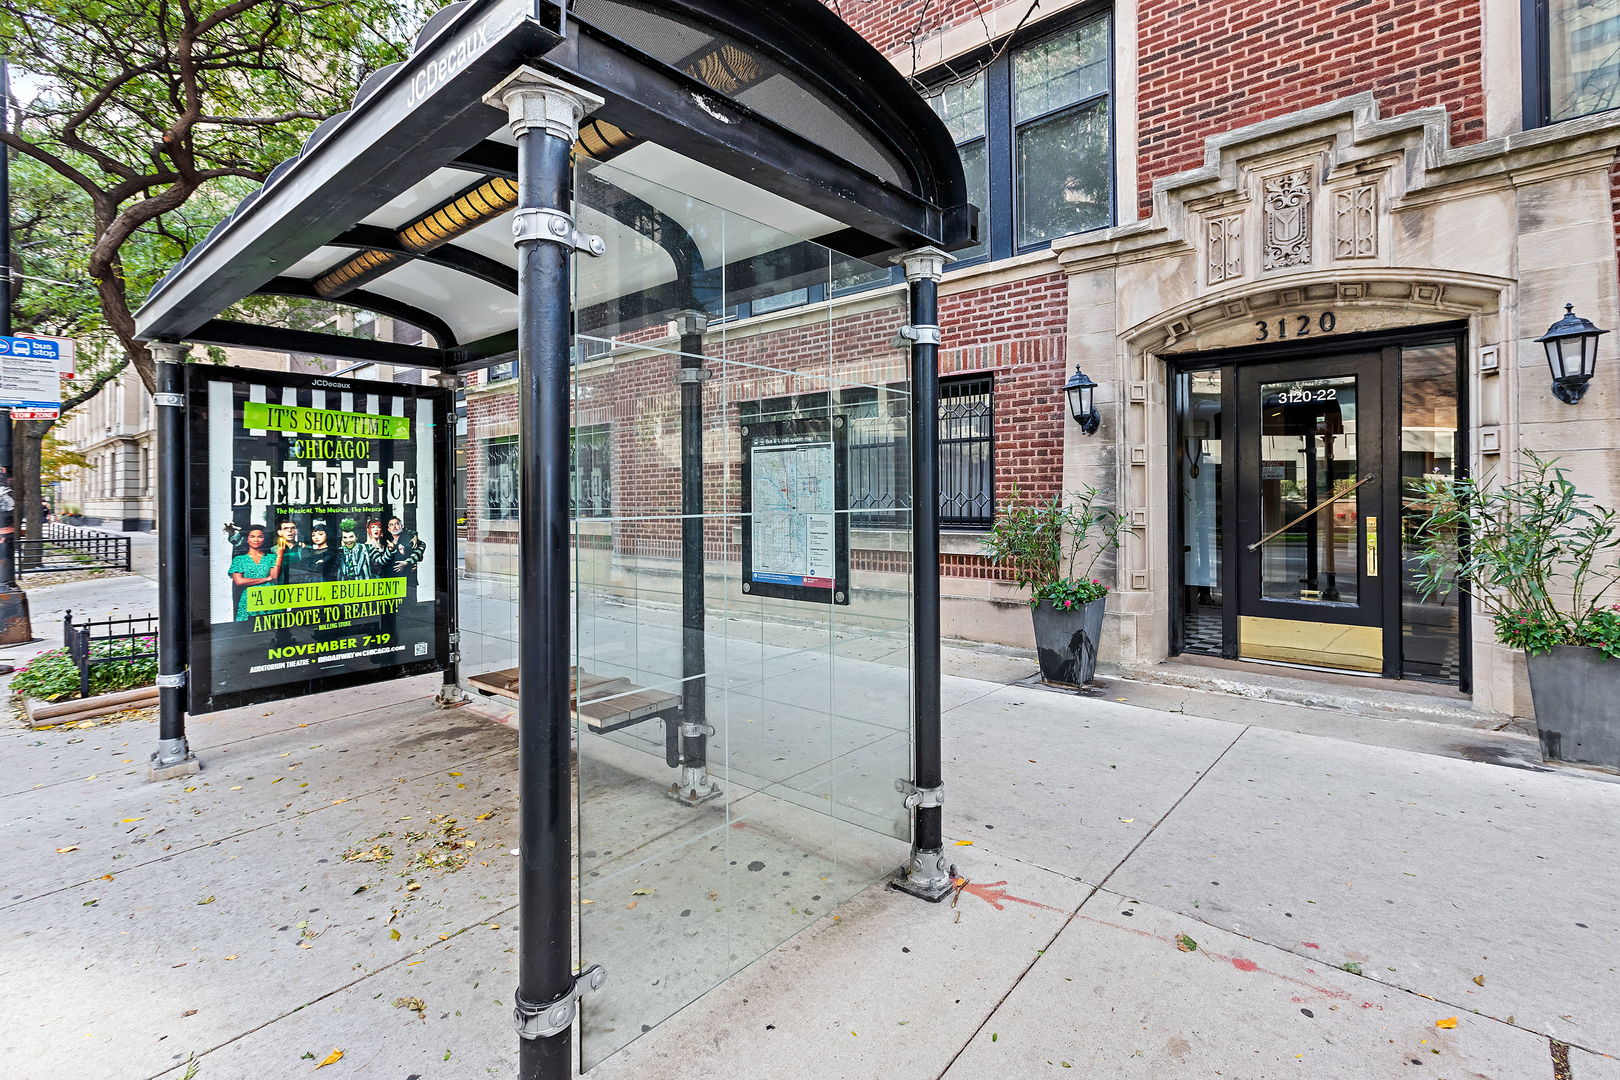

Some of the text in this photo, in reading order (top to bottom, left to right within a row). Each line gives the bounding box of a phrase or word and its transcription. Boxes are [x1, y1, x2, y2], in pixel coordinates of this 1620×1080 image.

[407, 24, 488, 108] JCDecaux
[1255, 311, 1336, 341] 3120
[33, 341, 52, 350] bus
[33, 349, 56, 358] stop
[311, 379, 351, 390] JCDecaux
[1278, 388, 1337, 404] 3120-22
[267, 407, 298, 429] IT'S
[294, 439, 370, 459] CHICAGO!
[233, 470, 418, 506] BEETLEJUICE
[276, 507, 288, 515] The
[269, 586, 327, 605] JOYFUL,
[331, 580, 400, 600] EBULLIENT
[252, 608, 321, 633] ANTIDOTE
[324, 606, 341, 622] TO
[268, 633, 391, 660] NOVEMBER 7-19
[249, 662, 286, 674] AUDITORIUM
[286, 658, 310, 669] THEATRE
